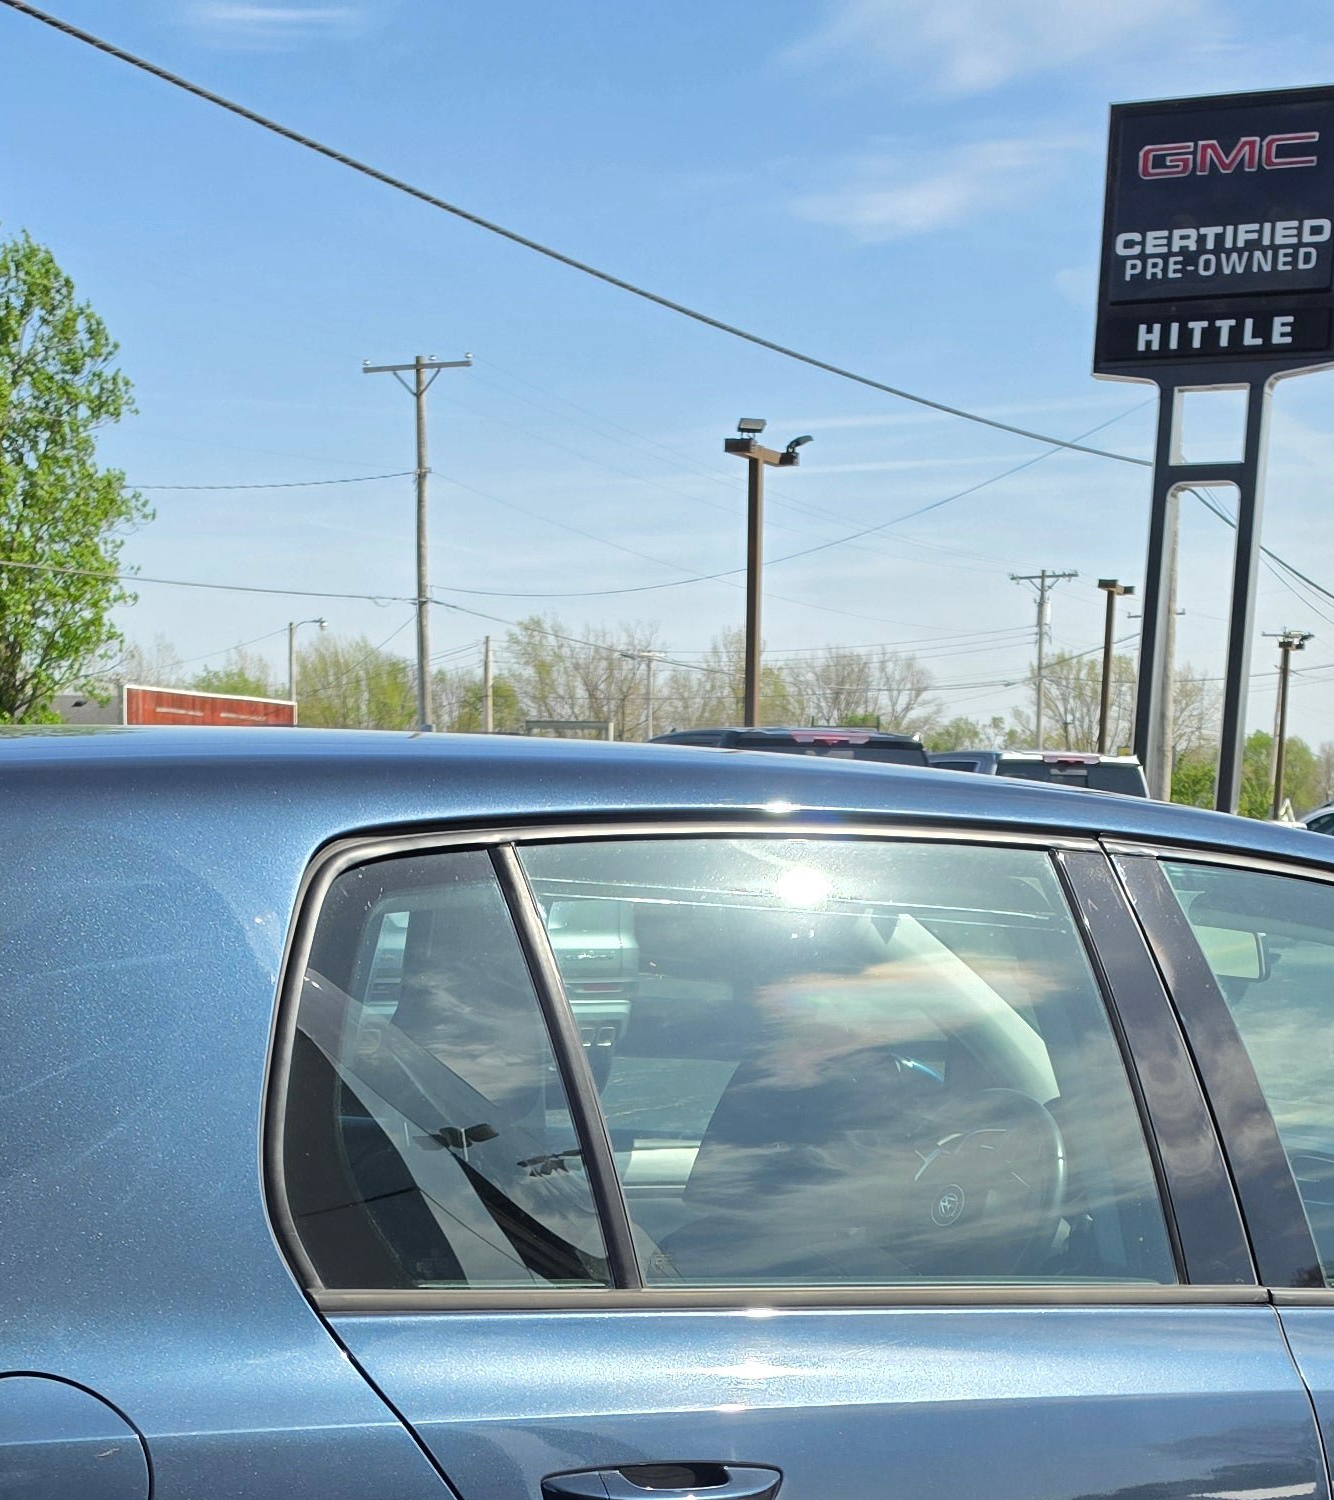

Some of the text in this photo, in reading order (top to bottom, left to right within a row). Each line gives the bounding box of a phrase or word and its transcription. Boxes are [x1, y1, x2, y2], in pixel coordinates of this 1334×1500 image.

[1139, 132, 1319, 180] GMC
[1115, 218, 1332, 256] CERTIFIED
[1124, 247, 1317, 281] PRE-OWNED
[1137, 315, 1295, 351] HITTLE
